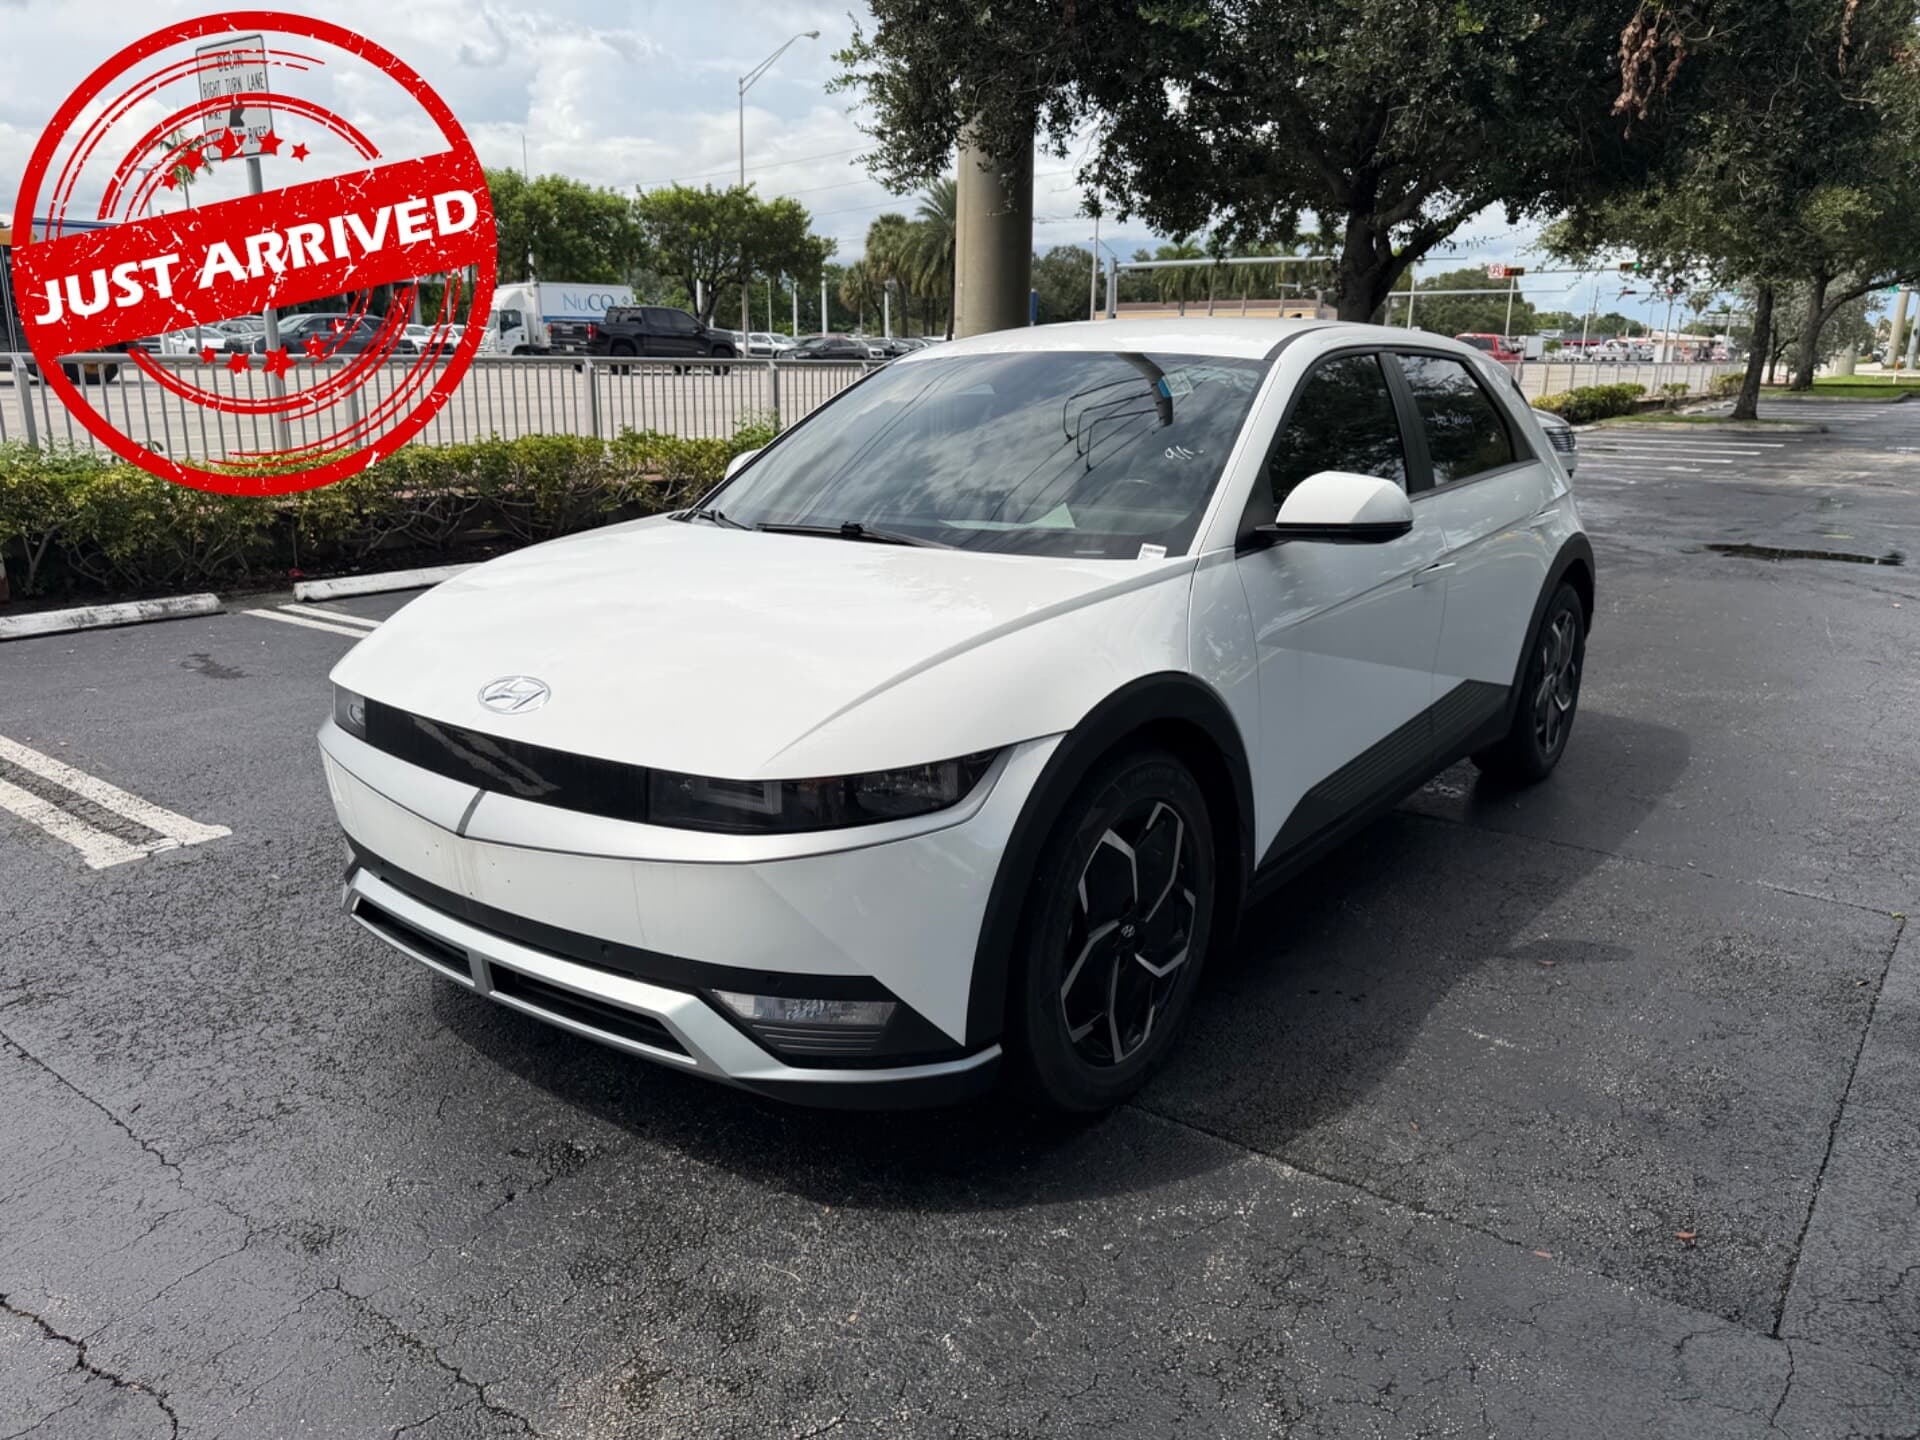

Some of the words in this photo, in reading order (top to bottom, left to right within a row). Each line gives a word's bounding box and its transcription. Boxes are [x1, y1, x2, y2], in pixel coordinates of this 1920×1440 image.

[202, 80, 221, 98] RIGHT
[225, 76, 242, 95] TURN
[247, 71, 265, 91] LANE
